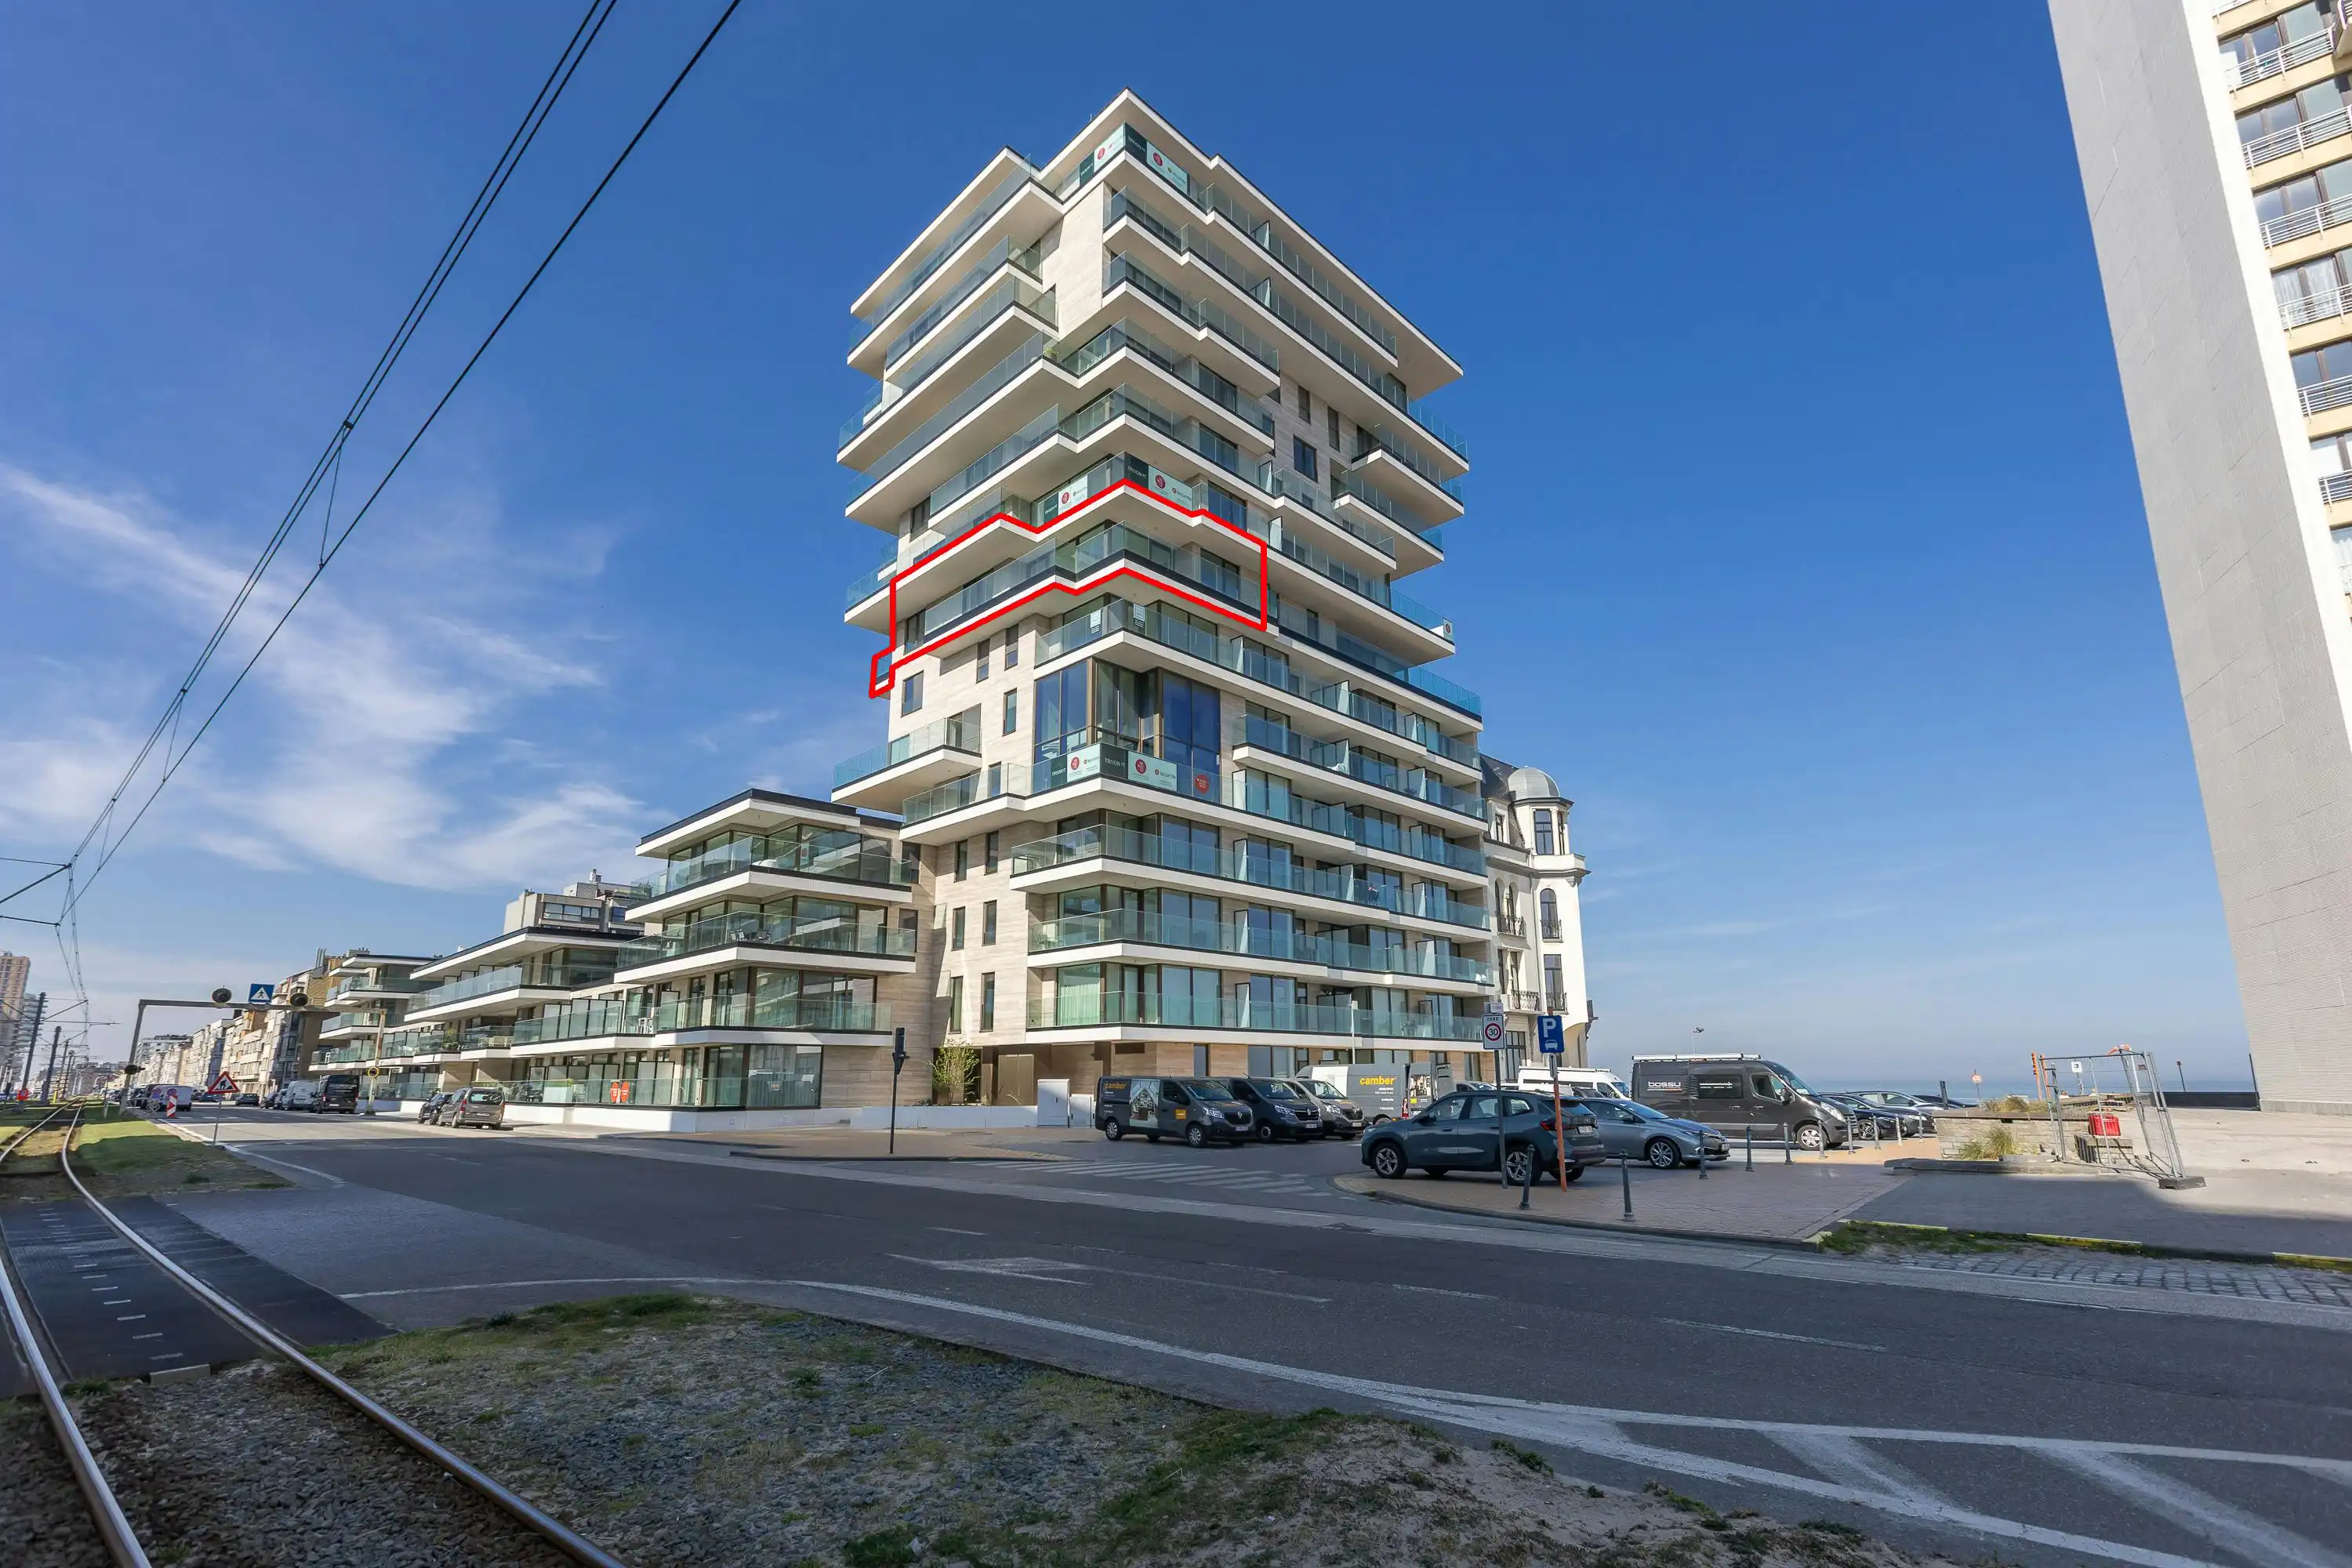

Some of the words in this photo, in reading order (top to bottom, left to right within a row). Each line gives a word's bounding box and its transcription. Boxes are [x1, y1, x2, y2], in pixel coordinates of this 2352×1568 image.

[1542, 1018, 1557, 1038] P
[1359, 1075, 1392, 1085] camber
[1104, 1081, 1127, 1090] camber
